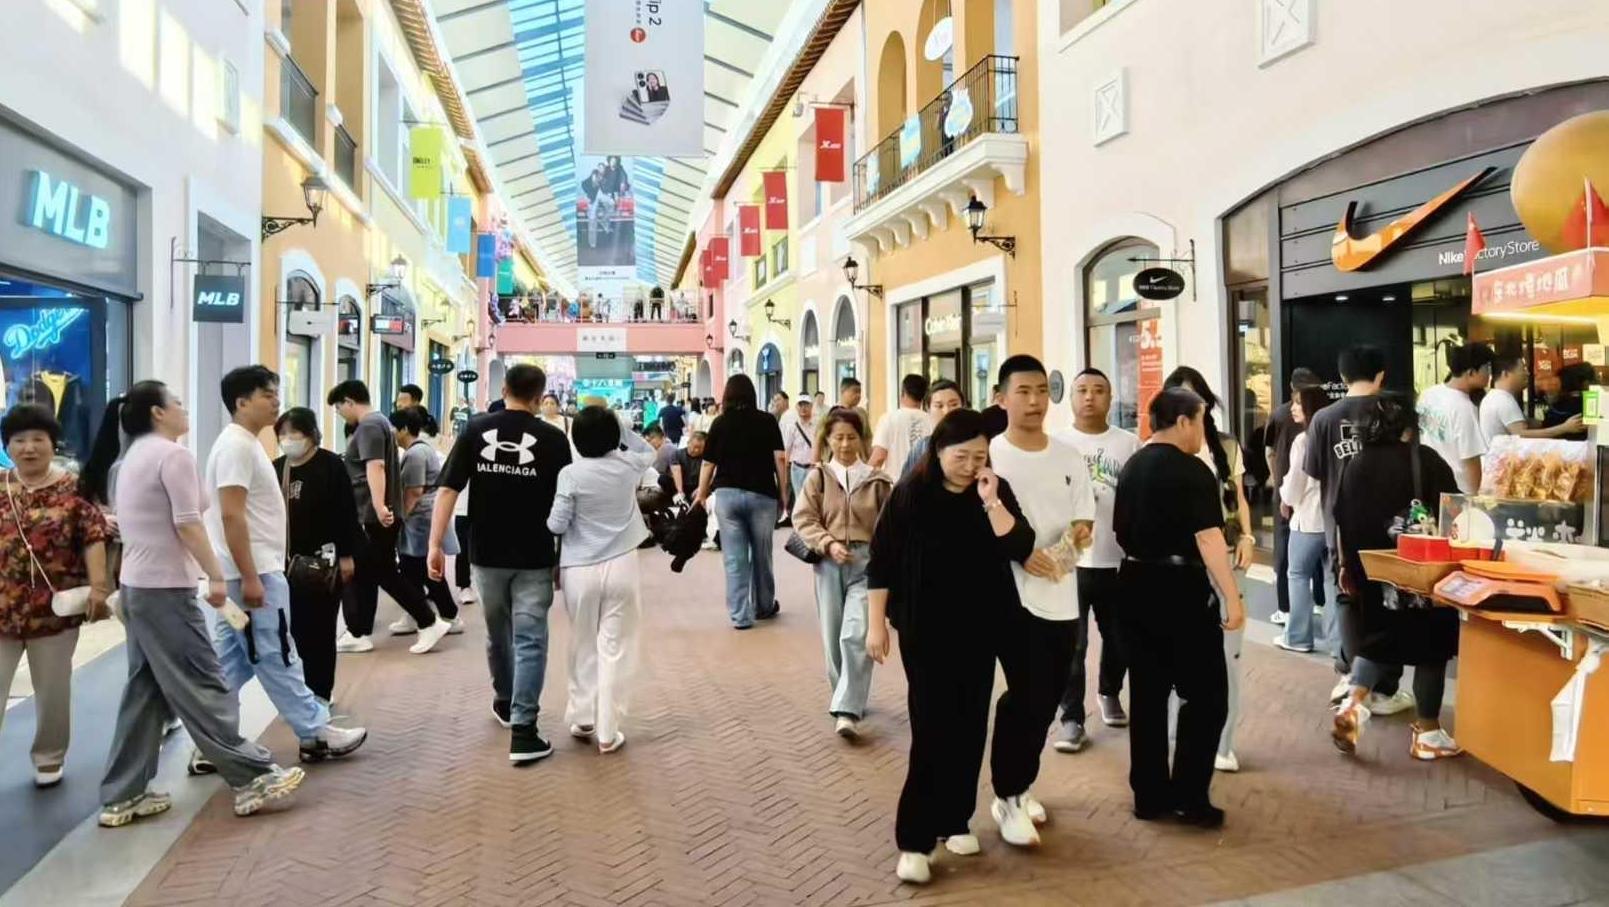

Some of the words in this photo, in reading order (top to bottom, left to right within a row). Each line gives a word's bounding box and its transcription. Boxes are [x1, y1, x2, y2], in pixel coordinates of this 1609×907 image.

[648, 17, 662, 26] 2
[32, 169, 111, 250] MLB
[1438, 249, 1464, 266] Nike
[1506, 240, 1540, 256] Store
[197, 291, 241, 306] MLB
